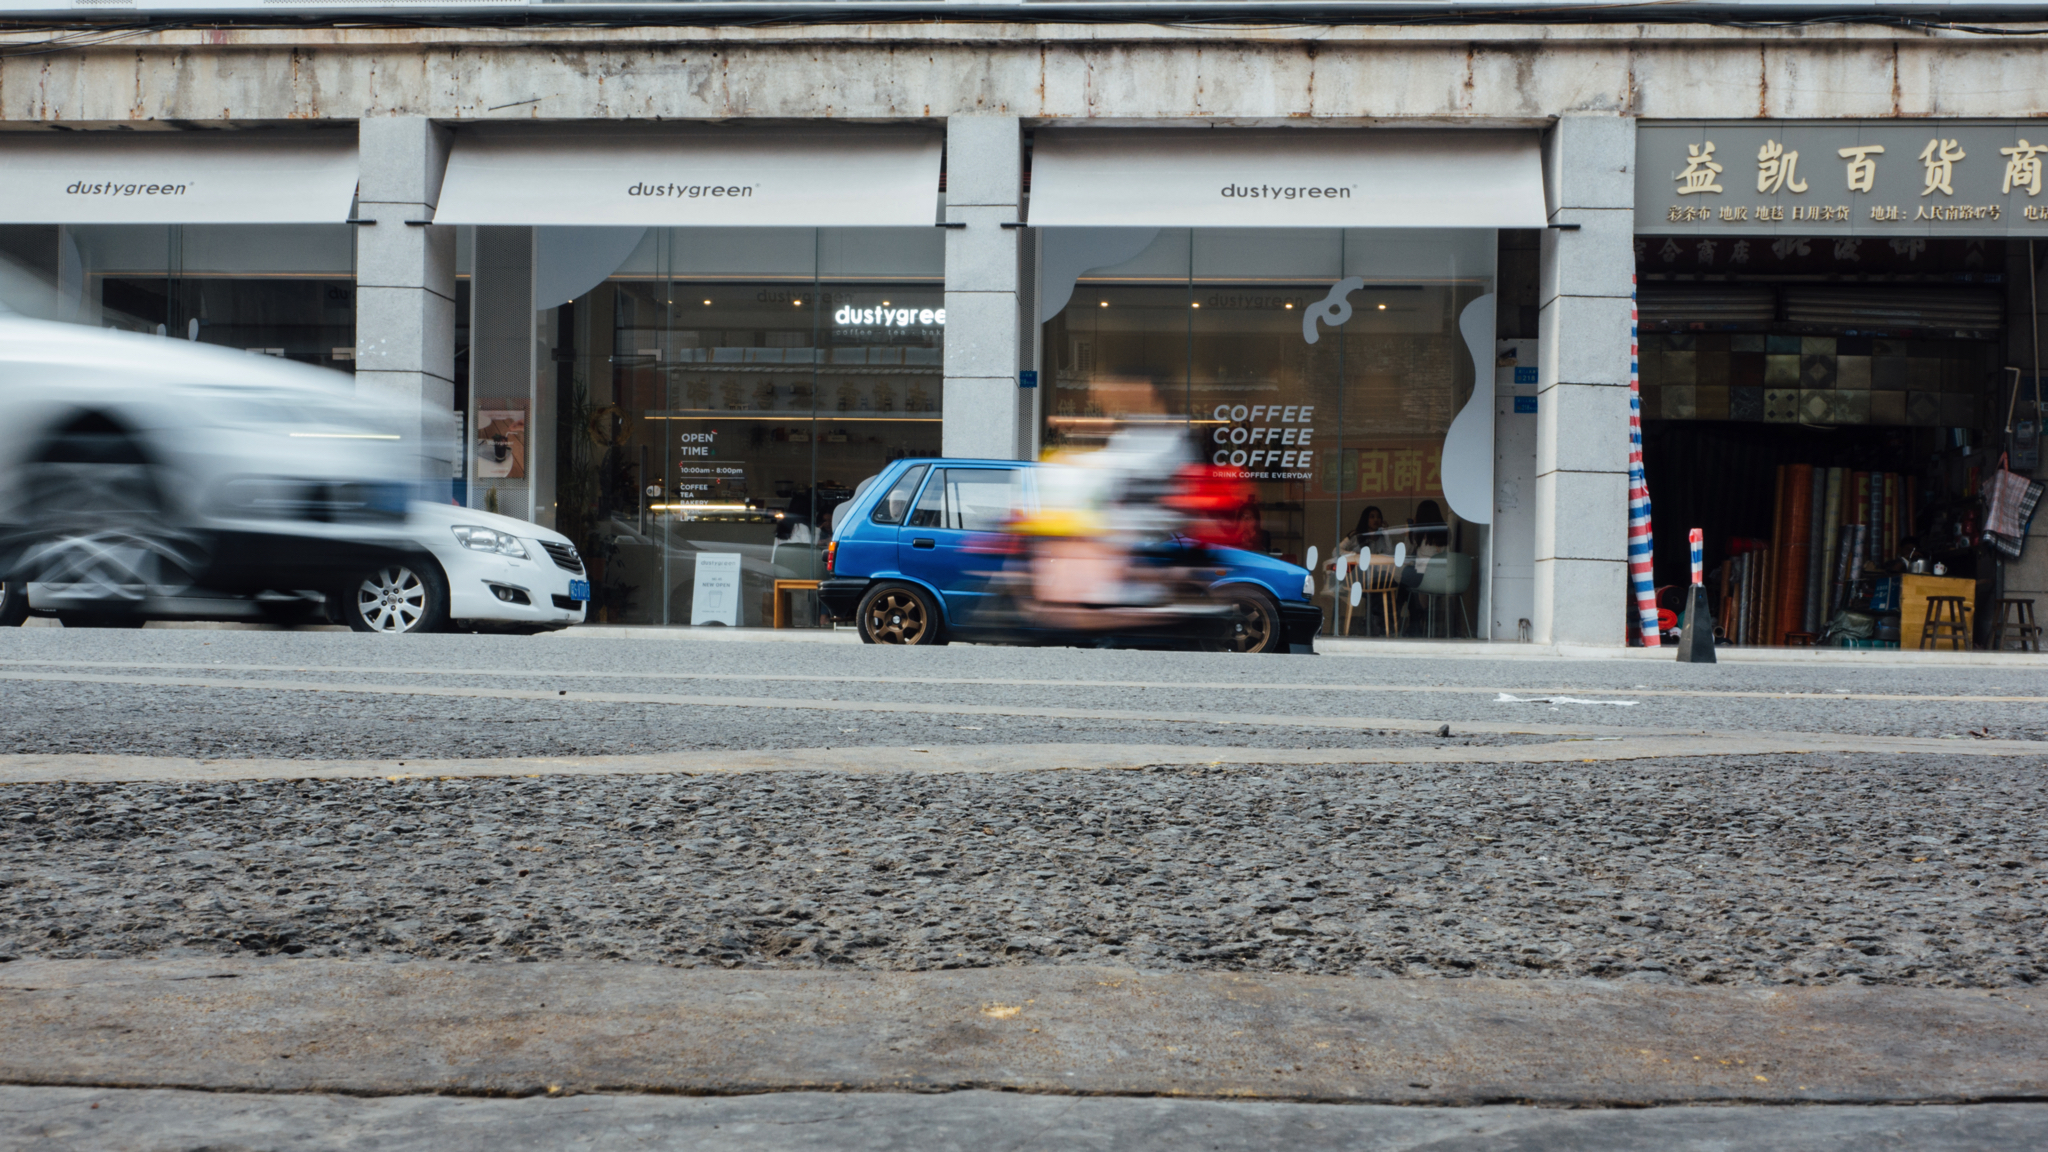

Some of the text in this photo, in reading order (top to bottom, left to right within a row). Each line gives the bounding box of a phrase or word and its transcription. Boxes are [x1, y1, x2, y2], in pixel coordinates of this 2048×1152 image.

[1675, 139, 2048, 196] 益凯百货商
[66, 180, 187, 197] dustygreen
[628, 181, 753, 199] dustygreen
[1220, 183, 1351, 200] dustygreen
[1755, 204, 1785, 222] 地毯
[1792, 204, 1850, 222] 日用杂货
[1213, 404, 1315, 423] COFFEE
[681, 433, 714, 443] OPEN
[1213, 426, 1315, 445] COFFEE
[681, 446, 709, 456] TIME
[1212, 449, 1314, 468] COFFEE
[1238, 471, 1270, 479] COFFEE
